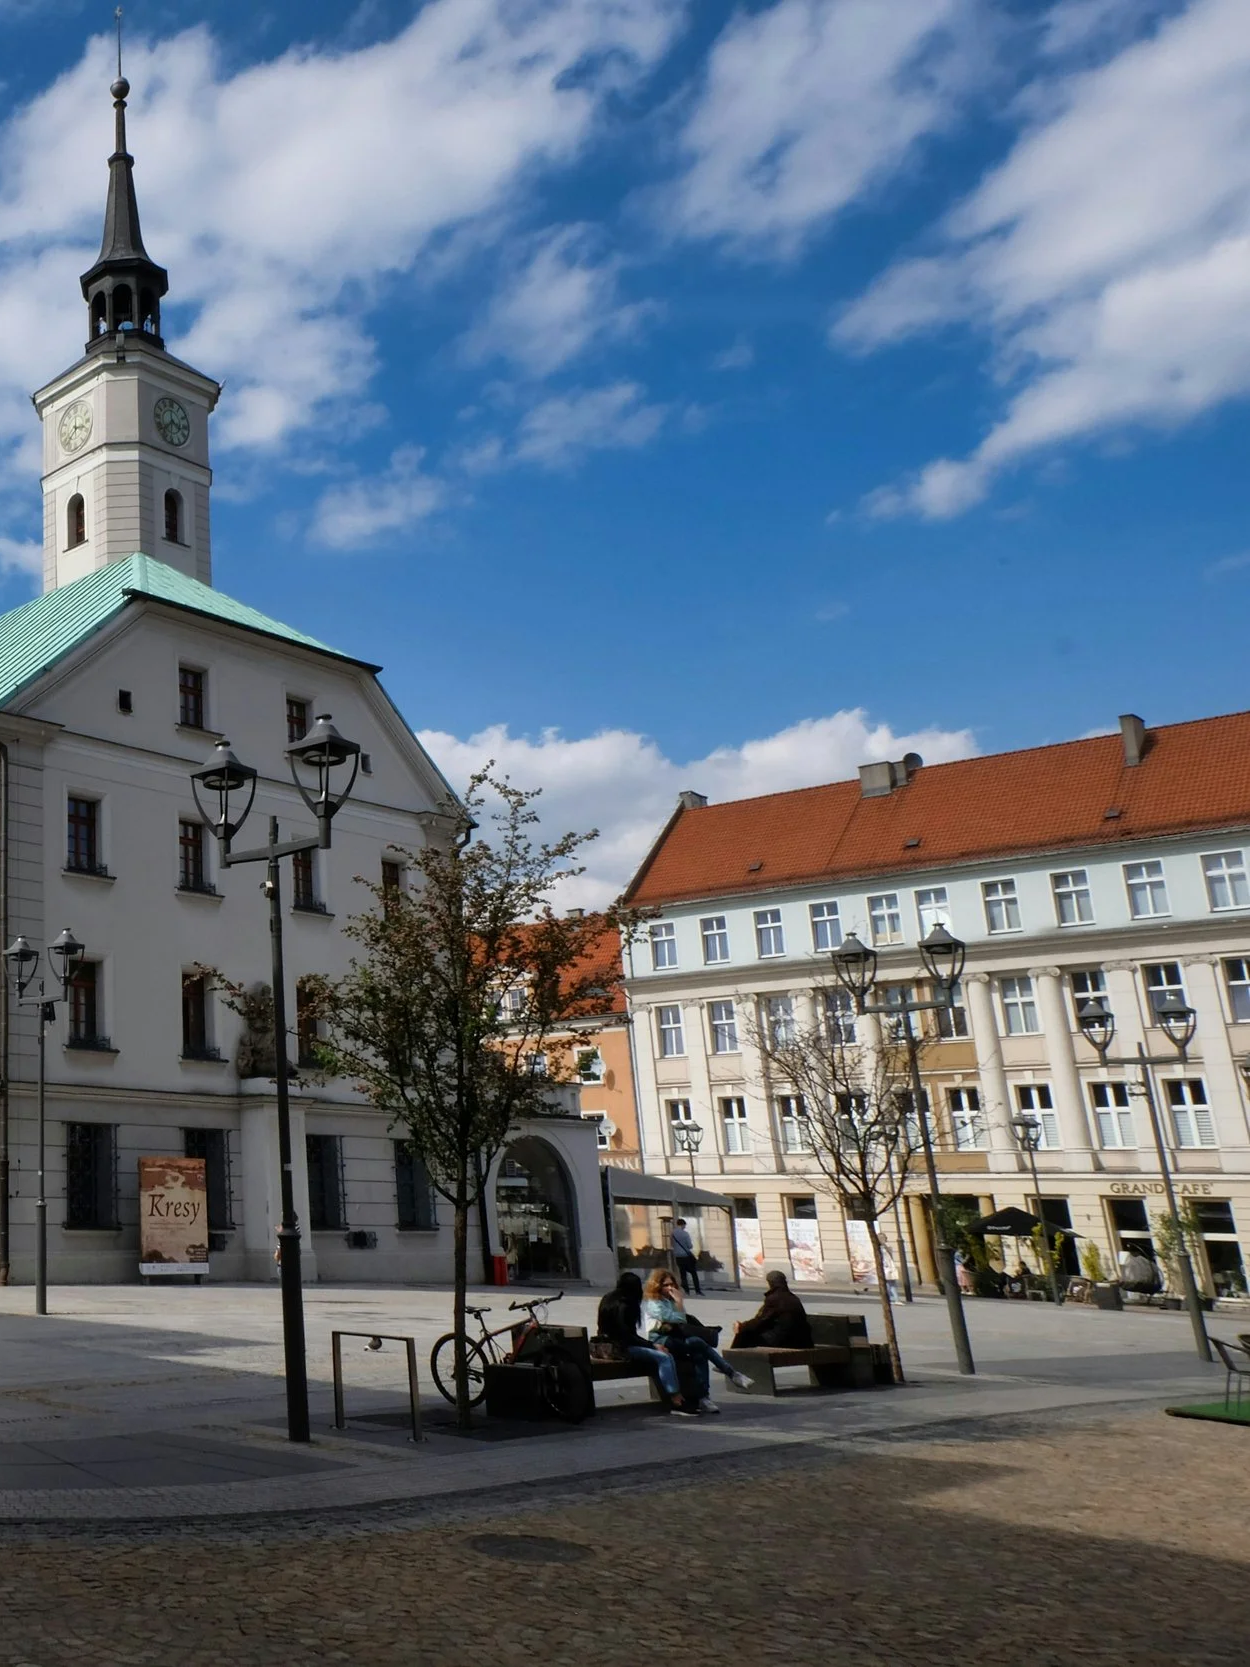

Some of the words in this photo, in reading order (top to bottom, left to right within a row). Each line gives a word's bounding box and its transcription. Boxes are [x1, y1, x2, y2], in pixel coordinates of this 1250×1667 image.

[598, 1157, 639, 1170] MSKI
[1110, 1182, 1165, 1194] GRAND
[148, 1193, 200, 1226] Kresy
